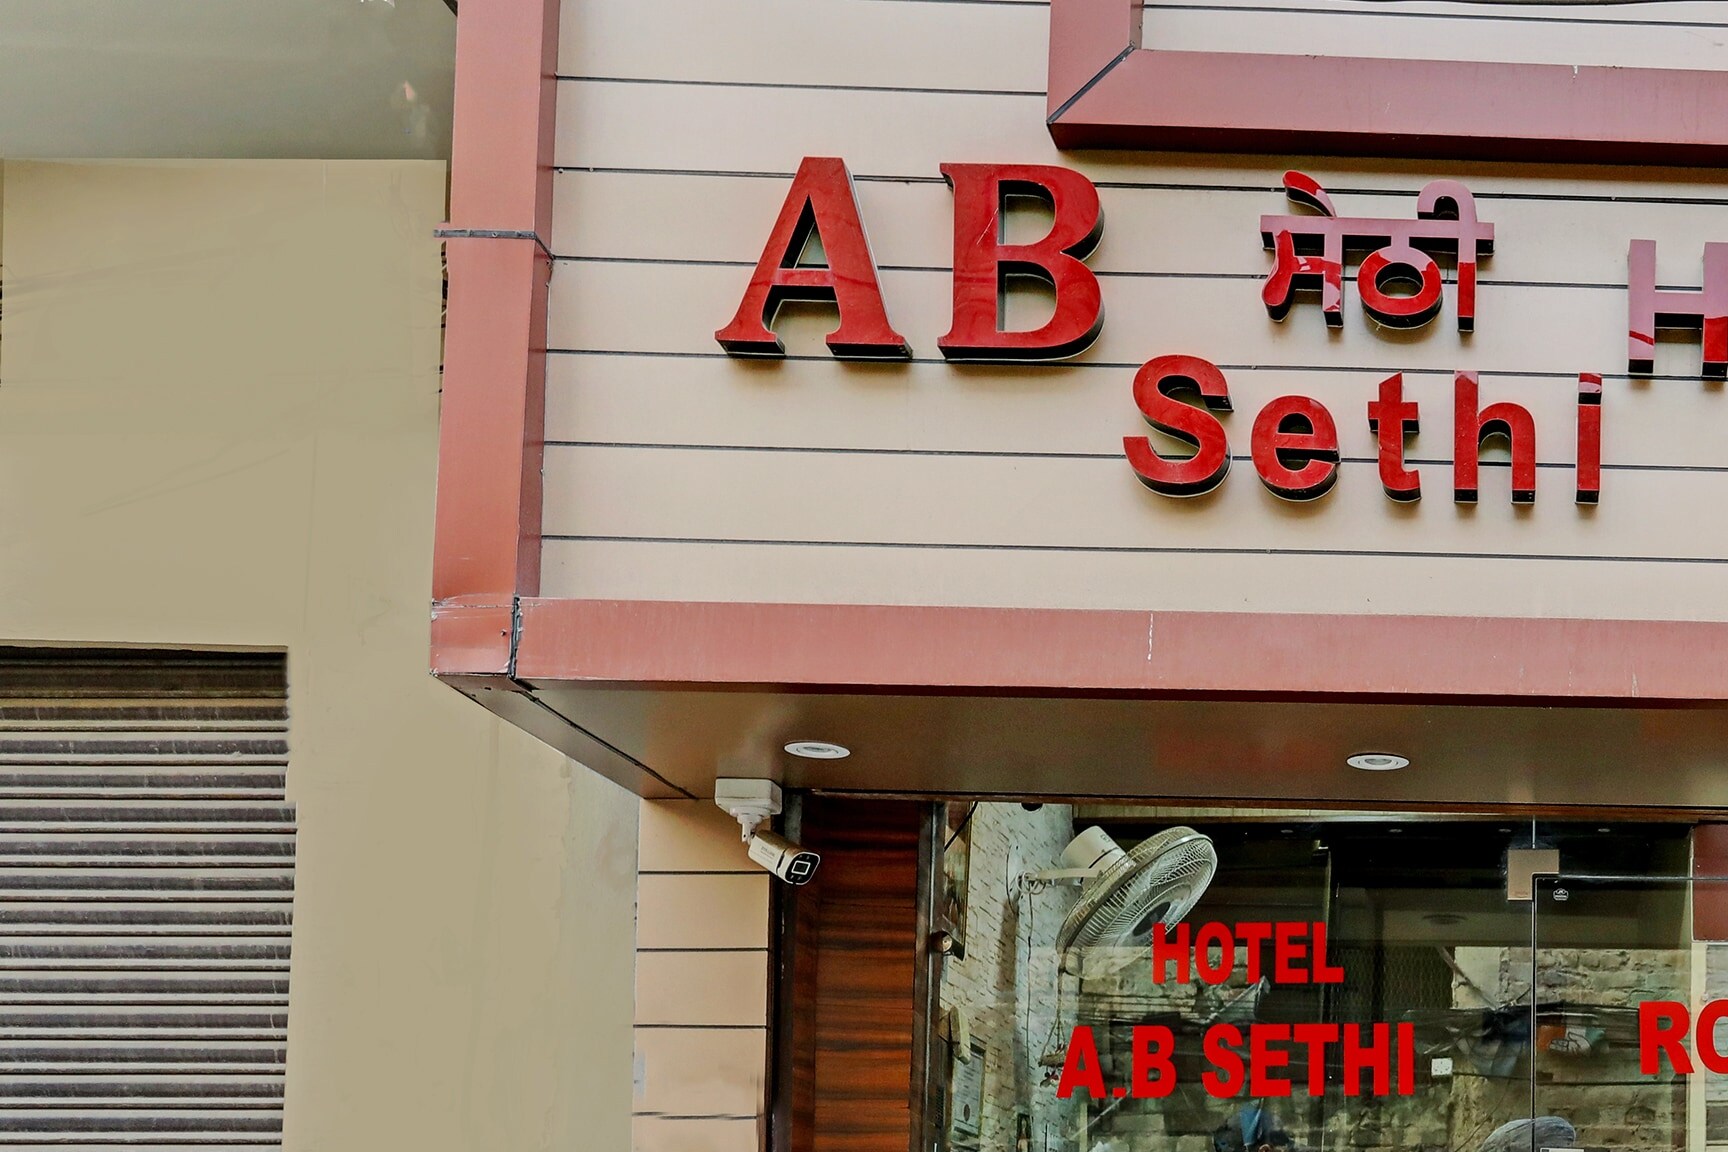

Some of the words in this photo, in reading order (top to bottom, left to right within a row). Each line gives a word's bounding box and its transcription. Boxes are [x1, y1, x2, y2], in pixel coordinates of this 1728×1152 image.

[715, 156, 1105, 362] AB
[1123, 354, 1603, 504] Sethi
[1151, 921, 1345, 985] HOTEL
[1056, 1024, 1178, 1099] A.B
[1201, 1022, 1416, 1099] SETHI
